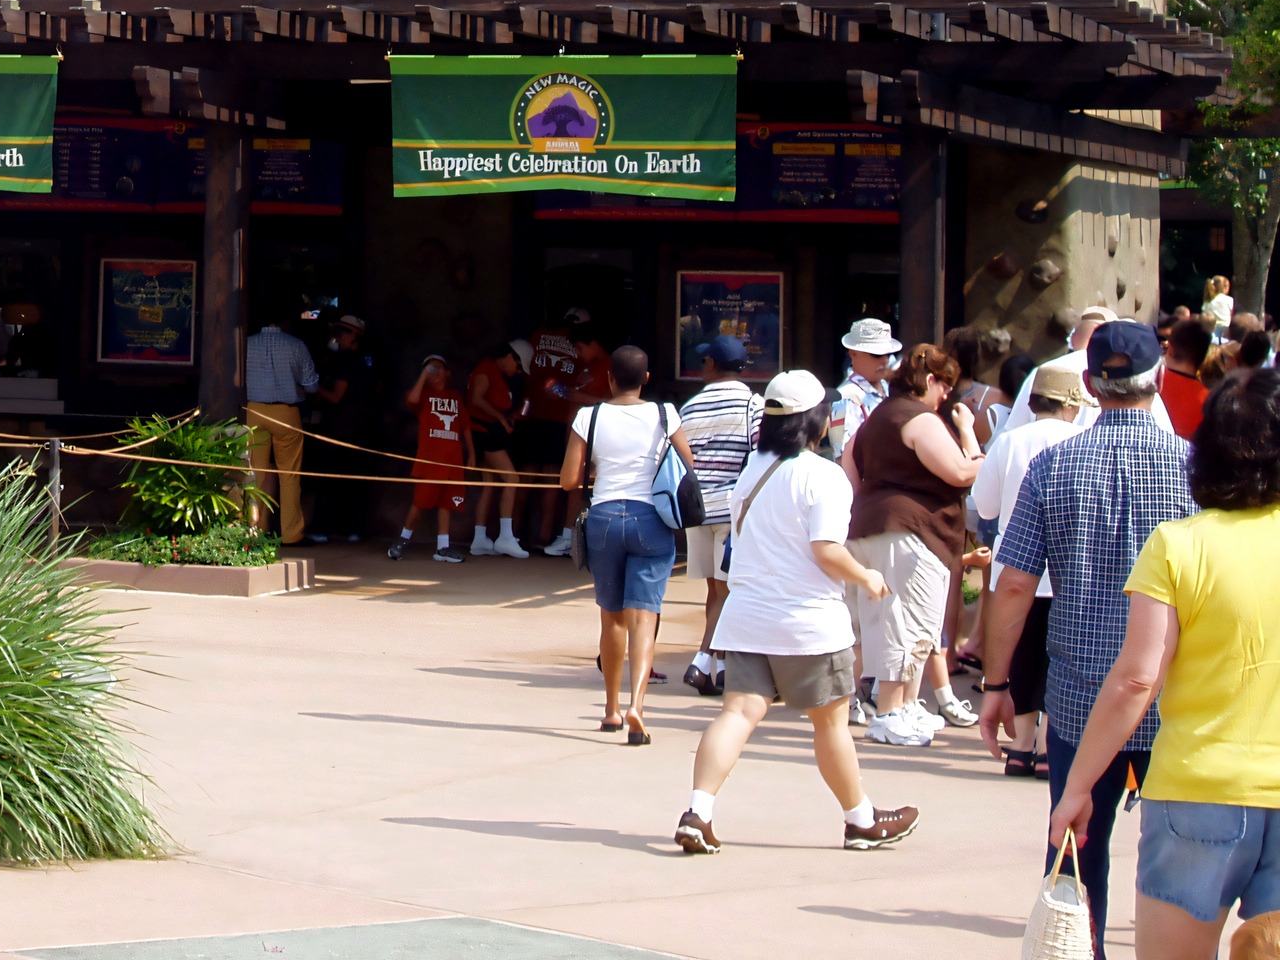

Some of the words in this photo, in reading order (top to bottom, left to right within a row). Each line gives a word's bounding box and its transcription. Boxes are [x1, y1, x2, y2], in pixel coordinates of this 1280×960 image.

[525, 75, 552, 100] NEW
[556, 73, 599, 100] MAGIC
[418, 149, 503, 179] Happiest
[507, 152, 608, 175] Celebration
[614, 154, 639, 174] On
[644, 151, 702, 175] Earth
